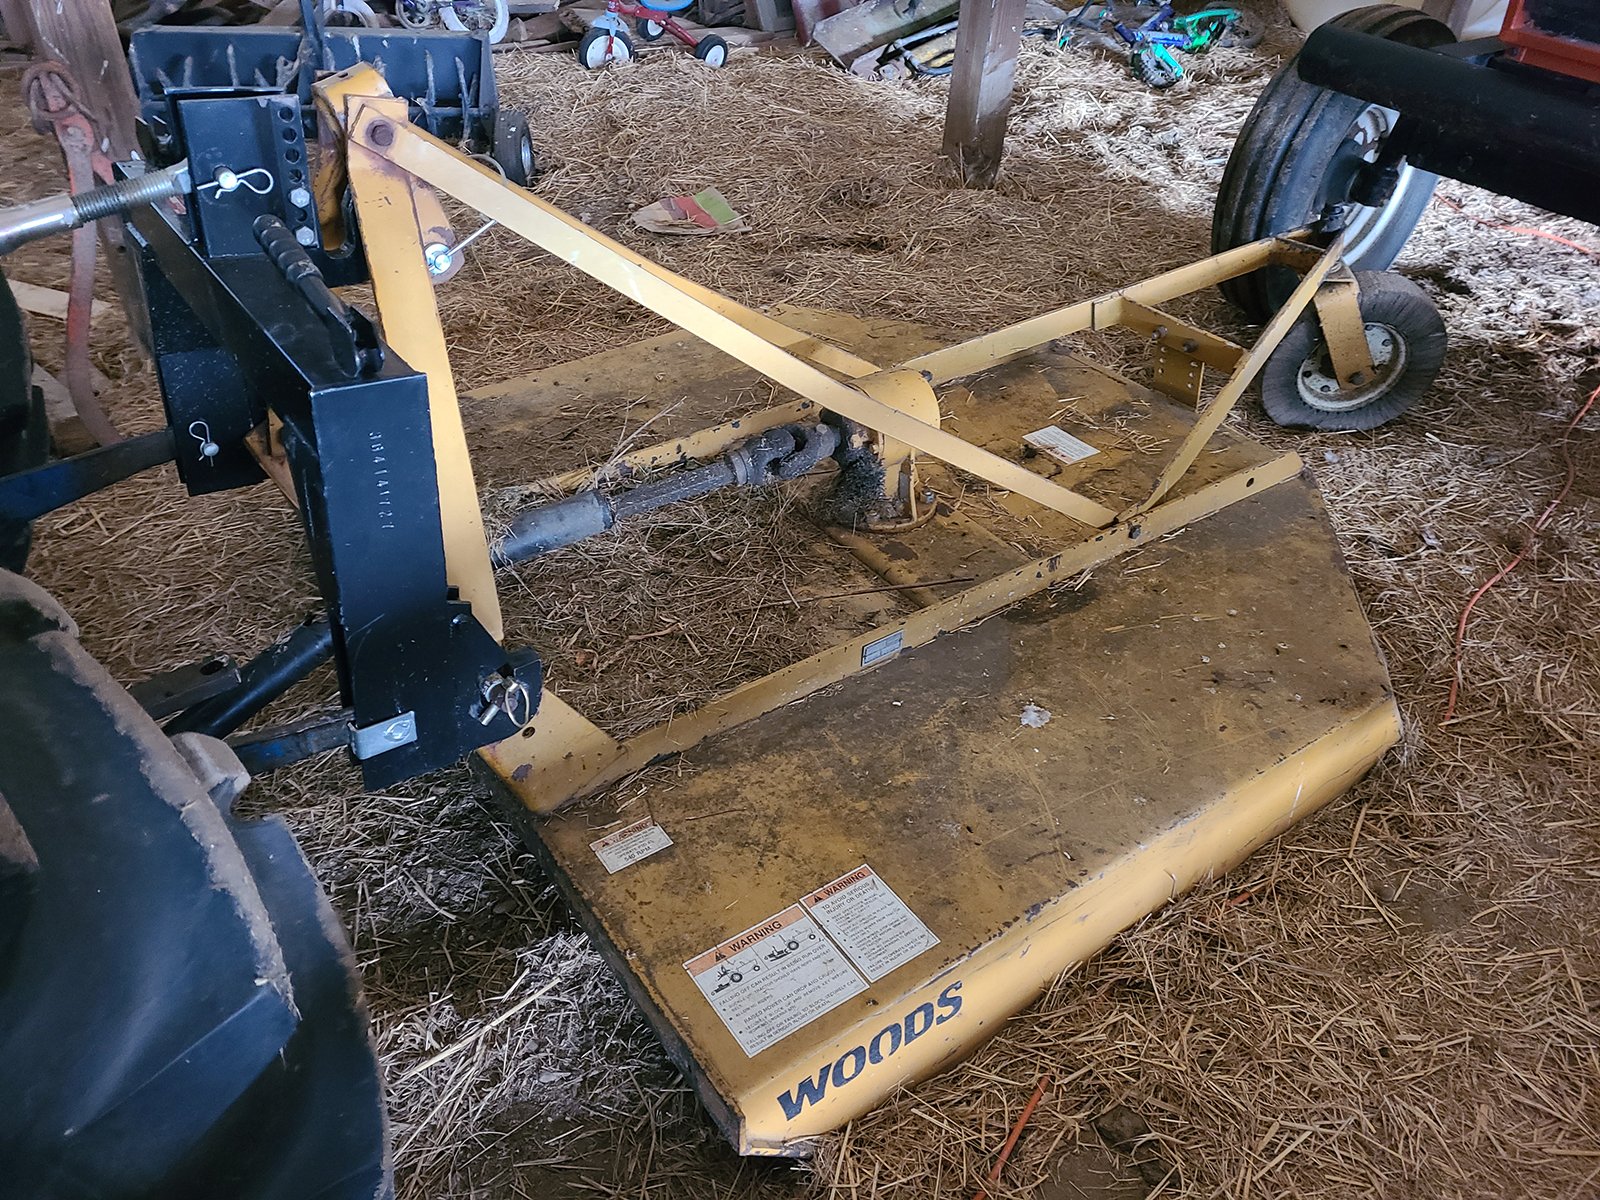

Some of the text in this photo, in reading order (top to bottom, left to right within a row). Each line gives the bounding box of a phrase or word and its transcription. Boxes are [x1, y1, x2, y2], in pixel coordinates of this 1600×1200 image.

[820, 903, 831, 911] TO
[829, 893, 848, 906] AVOID
[845, 881, 870, 897] SERIOUS
[823, 870, 866, 897] WARNING
[824, 901, 846, 915] INJURY
[844, 895, 855, 904] OR
[728, 919, 783, 953] WARNING
[749, 978, 762, 988] CAN
[781, 991, 794, 1001] CAN
[777, 980, 963, 1121] WOODS
